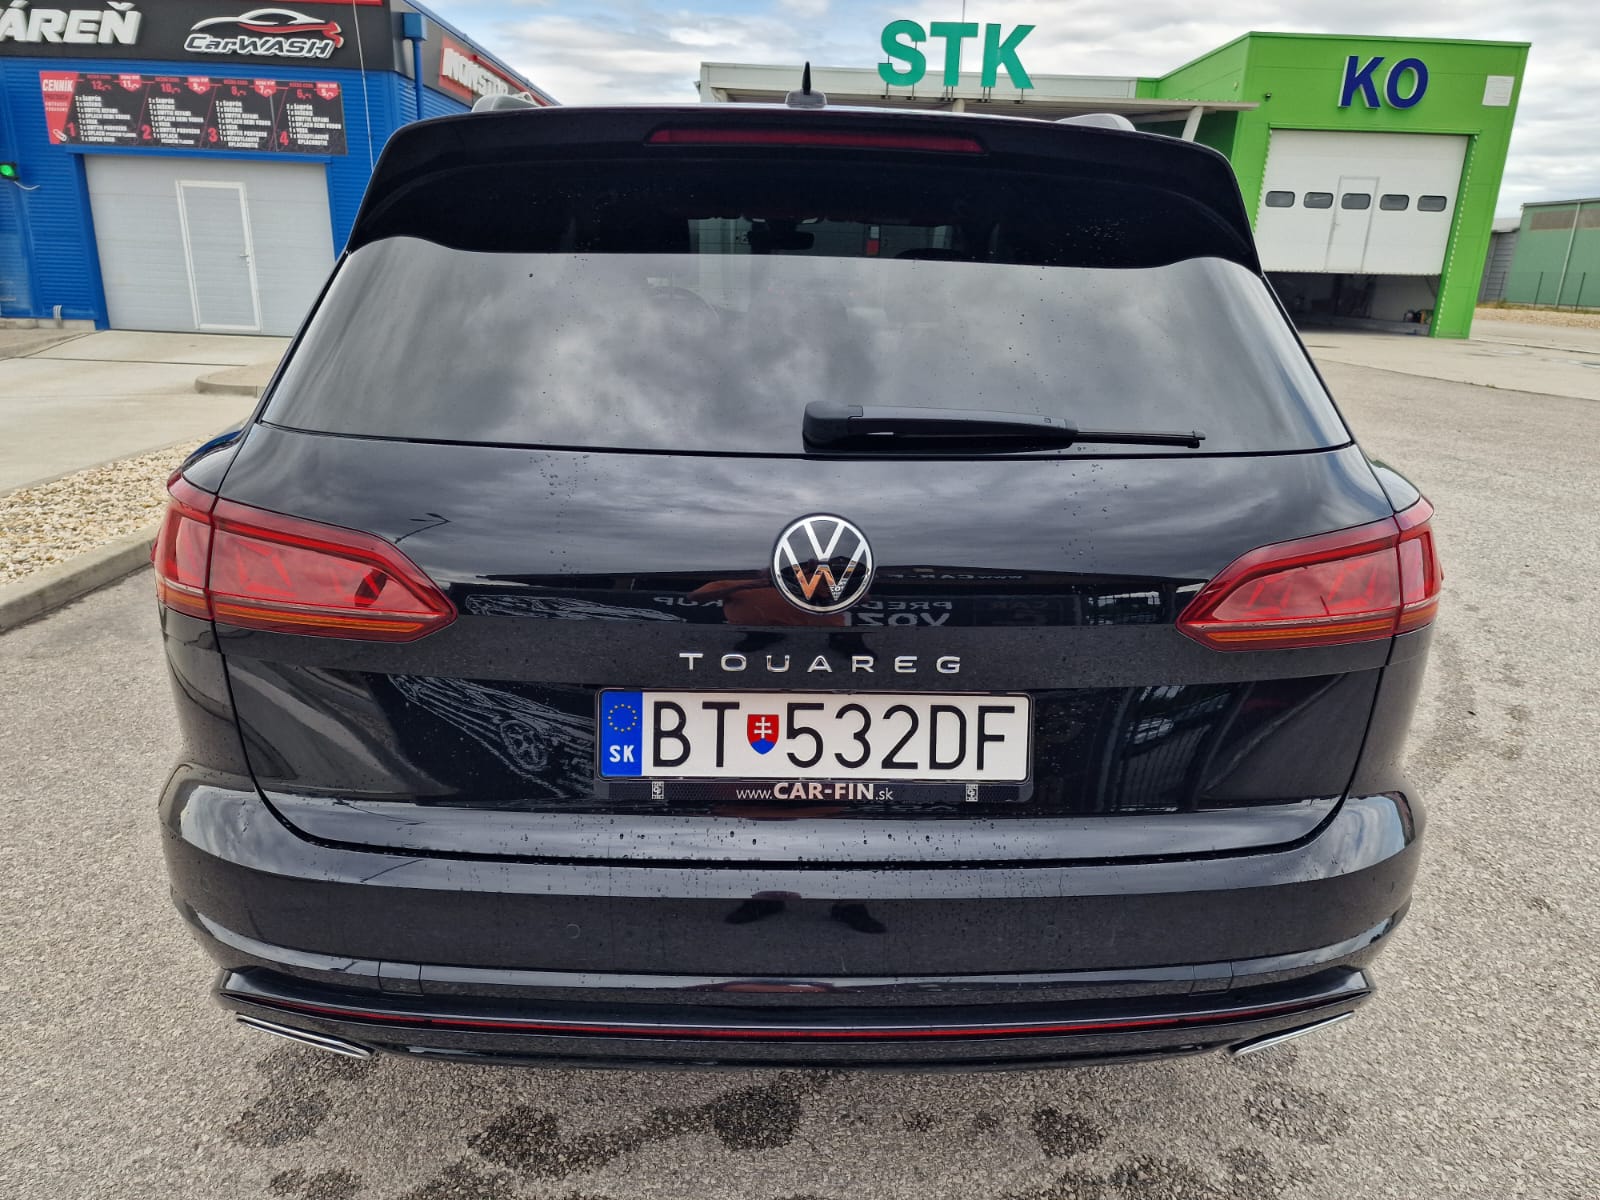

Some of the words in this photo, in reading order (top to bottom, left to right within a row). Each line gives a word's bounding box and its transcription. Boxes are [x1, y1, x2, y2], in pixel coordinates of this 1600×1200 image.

[0, 0, 142, 44] ÁREŇ
[184, 33, 336, 58] CarWASH
[878, 20, 1036, 89] STK
[42, 77, 74, 92] CENNÍK
[1337, 55, 1429, 109] KO
[67, 122, 76, 137] 1
[142, 125, 152, 139] 2
[208, 127, 218, 142] 3
[279, 131, 289, 146] 4
[679, 653, 961, 674] TOUAREG
[653, 701, 740, 768] BT
[786, 702, 1016, 770] 532DF
[609, 745, 635, 762] SK
[736, 782, 894, 801] www.CAR-FIN.sk
